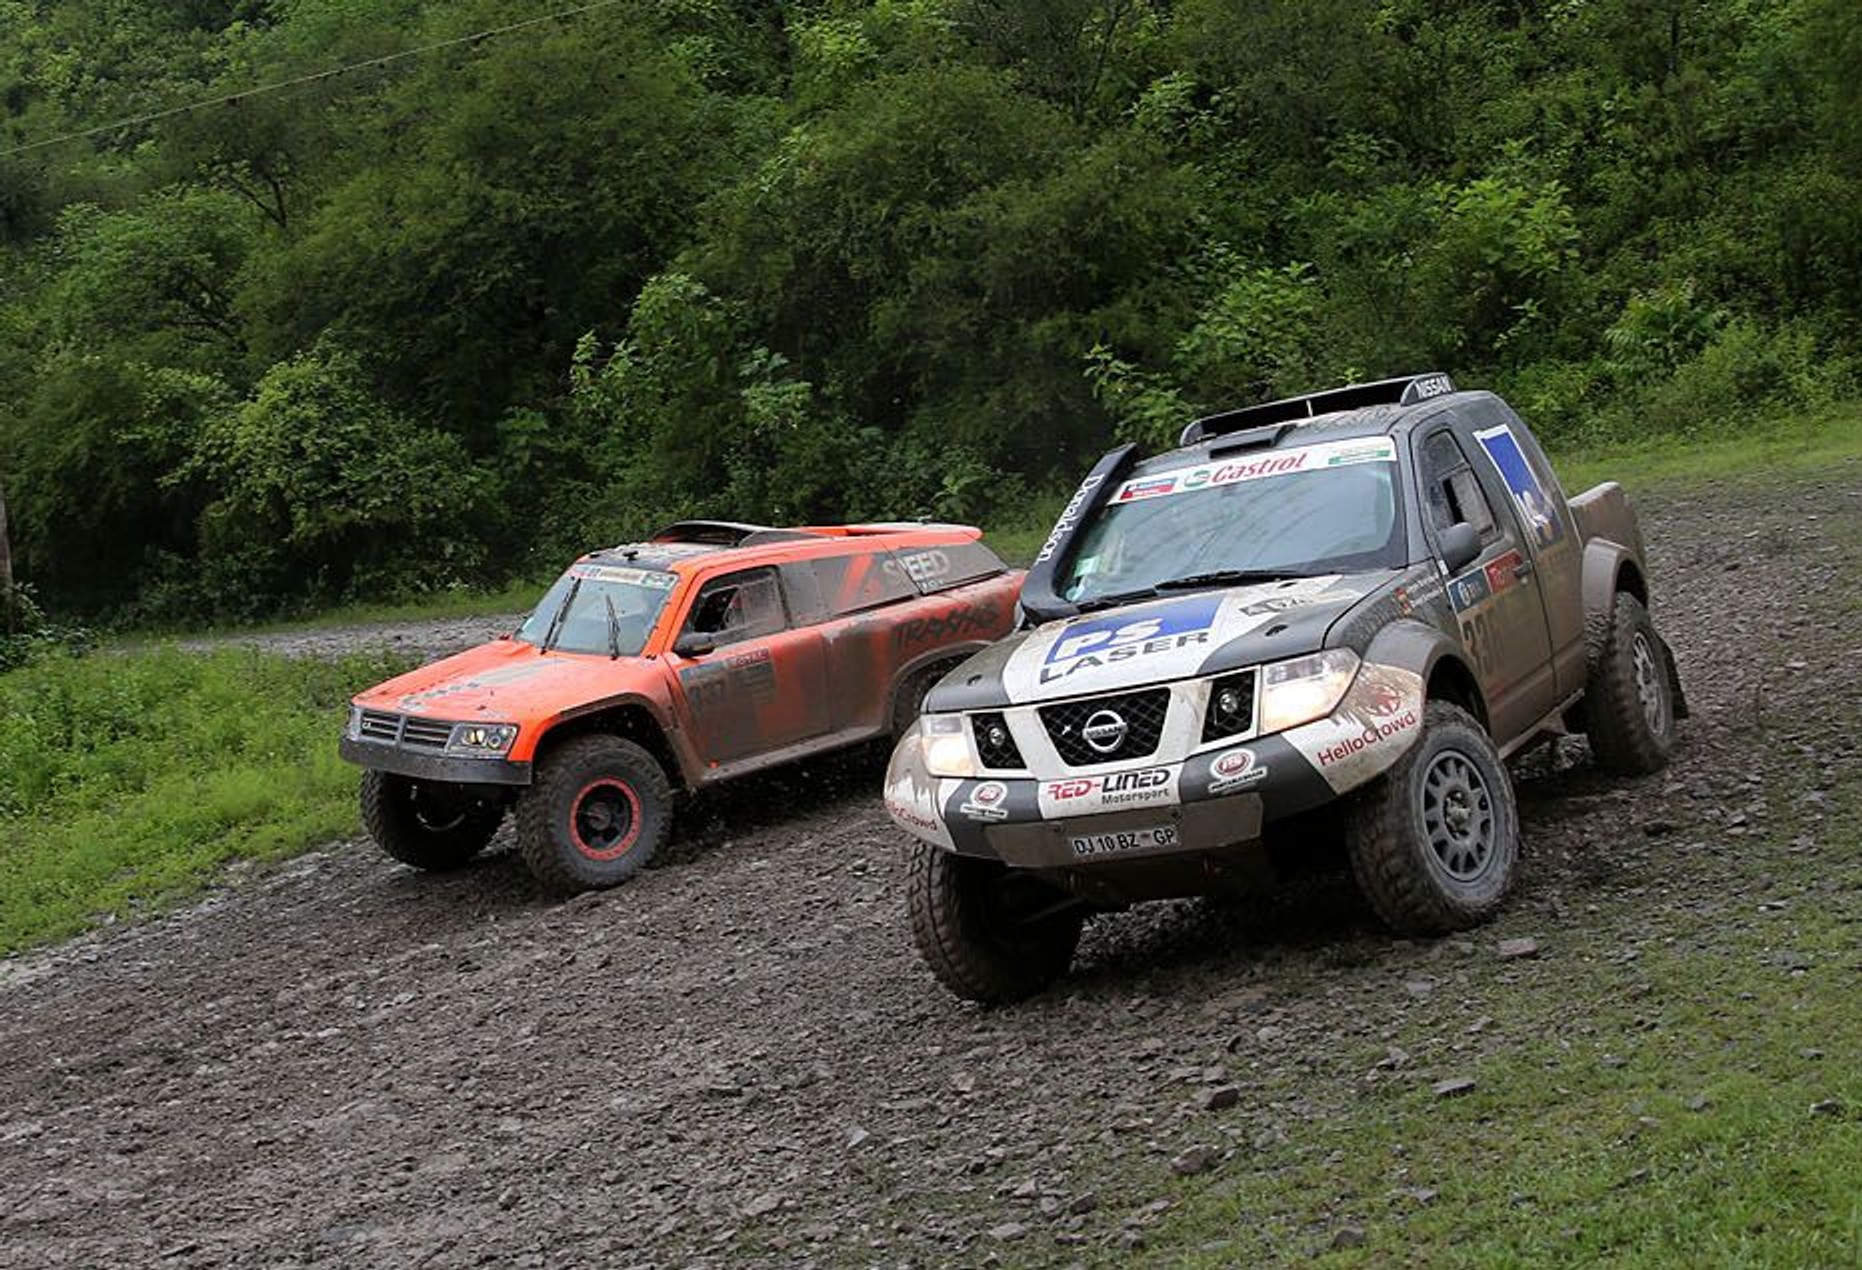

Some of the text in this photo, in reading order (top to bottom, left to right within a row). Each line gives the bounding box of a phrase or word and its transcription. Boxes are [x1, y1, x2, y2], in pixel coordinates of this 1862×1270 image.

[1415, 374, 1452, 400] NISSAN
[1212, 451, 1308, 483] Castrol
[1033, 473, 1106, 567] Donaldson
[1053, 617, 1164, 660] PS
[1039, 632, 1209, 686] LASER
[1317, 710, 1417, 767] HelloCrowd
[1048, 769, 1170, 800] RED-LINED
[1101, 787, 1170, 806] Motorsport
